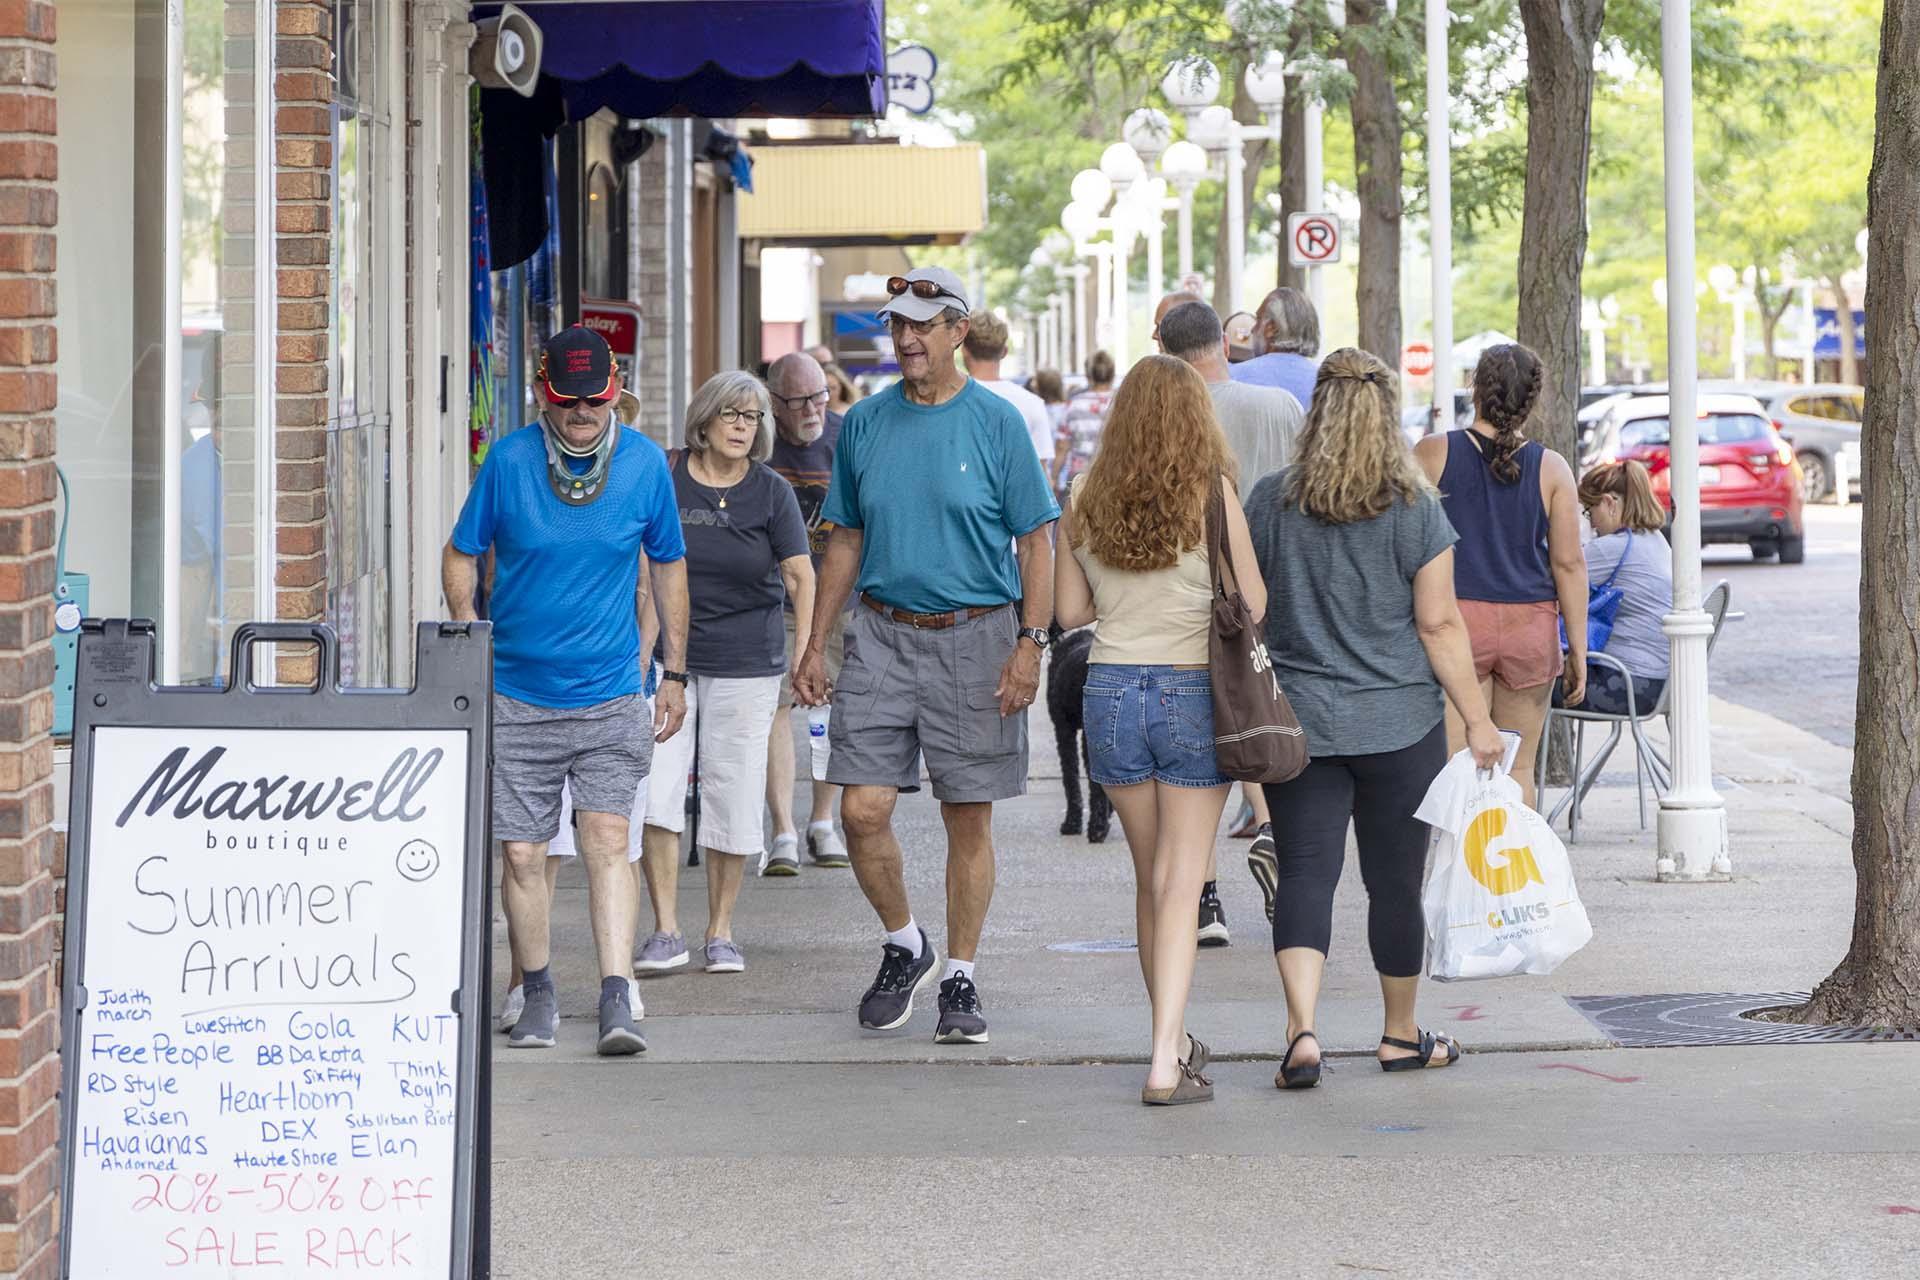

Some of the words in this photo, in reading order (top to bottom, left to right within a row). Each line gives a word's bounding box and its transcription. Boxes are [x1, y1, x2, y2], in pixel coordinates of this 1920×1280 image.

[115, 746, 444, 828] Maxwell
[206, 830, 348, 856] boutique
[1464, 807, 1545, 896] G
[127, 856, 373, 935] Summer
[181, 934, 417, 1001] Arrivals
[288, 1011, 355, 1040] Gola
[392, 1013, 452, 1044] KUT
[92, 1033, 148, 1065] Free
[153, 1033, 234, 1069] People
[257, 1045, 284, 1066] BB
[289, 1045, 364, 1064] Dakota
[88, 1072, 117, 1093] RD
[388, 1061, 449, 1079] Think
[219, 1081, 354, 1115] Heartloom
[124, 1107, 189, 1126] Risen
[261, 1118, 318, 1142] DEX
[425, 1109, 455, 1126] Riot
[83, 1126, 208, 1157] Havaianas
[351, 1132, 418, 1158] Elan
[233, 1152, 289, 1169] Haute
[291, 1148, 339, 1168] Shore
[165, 1227, 284, 1266] SALE
[306, 1227, 412, 1268] RACK
